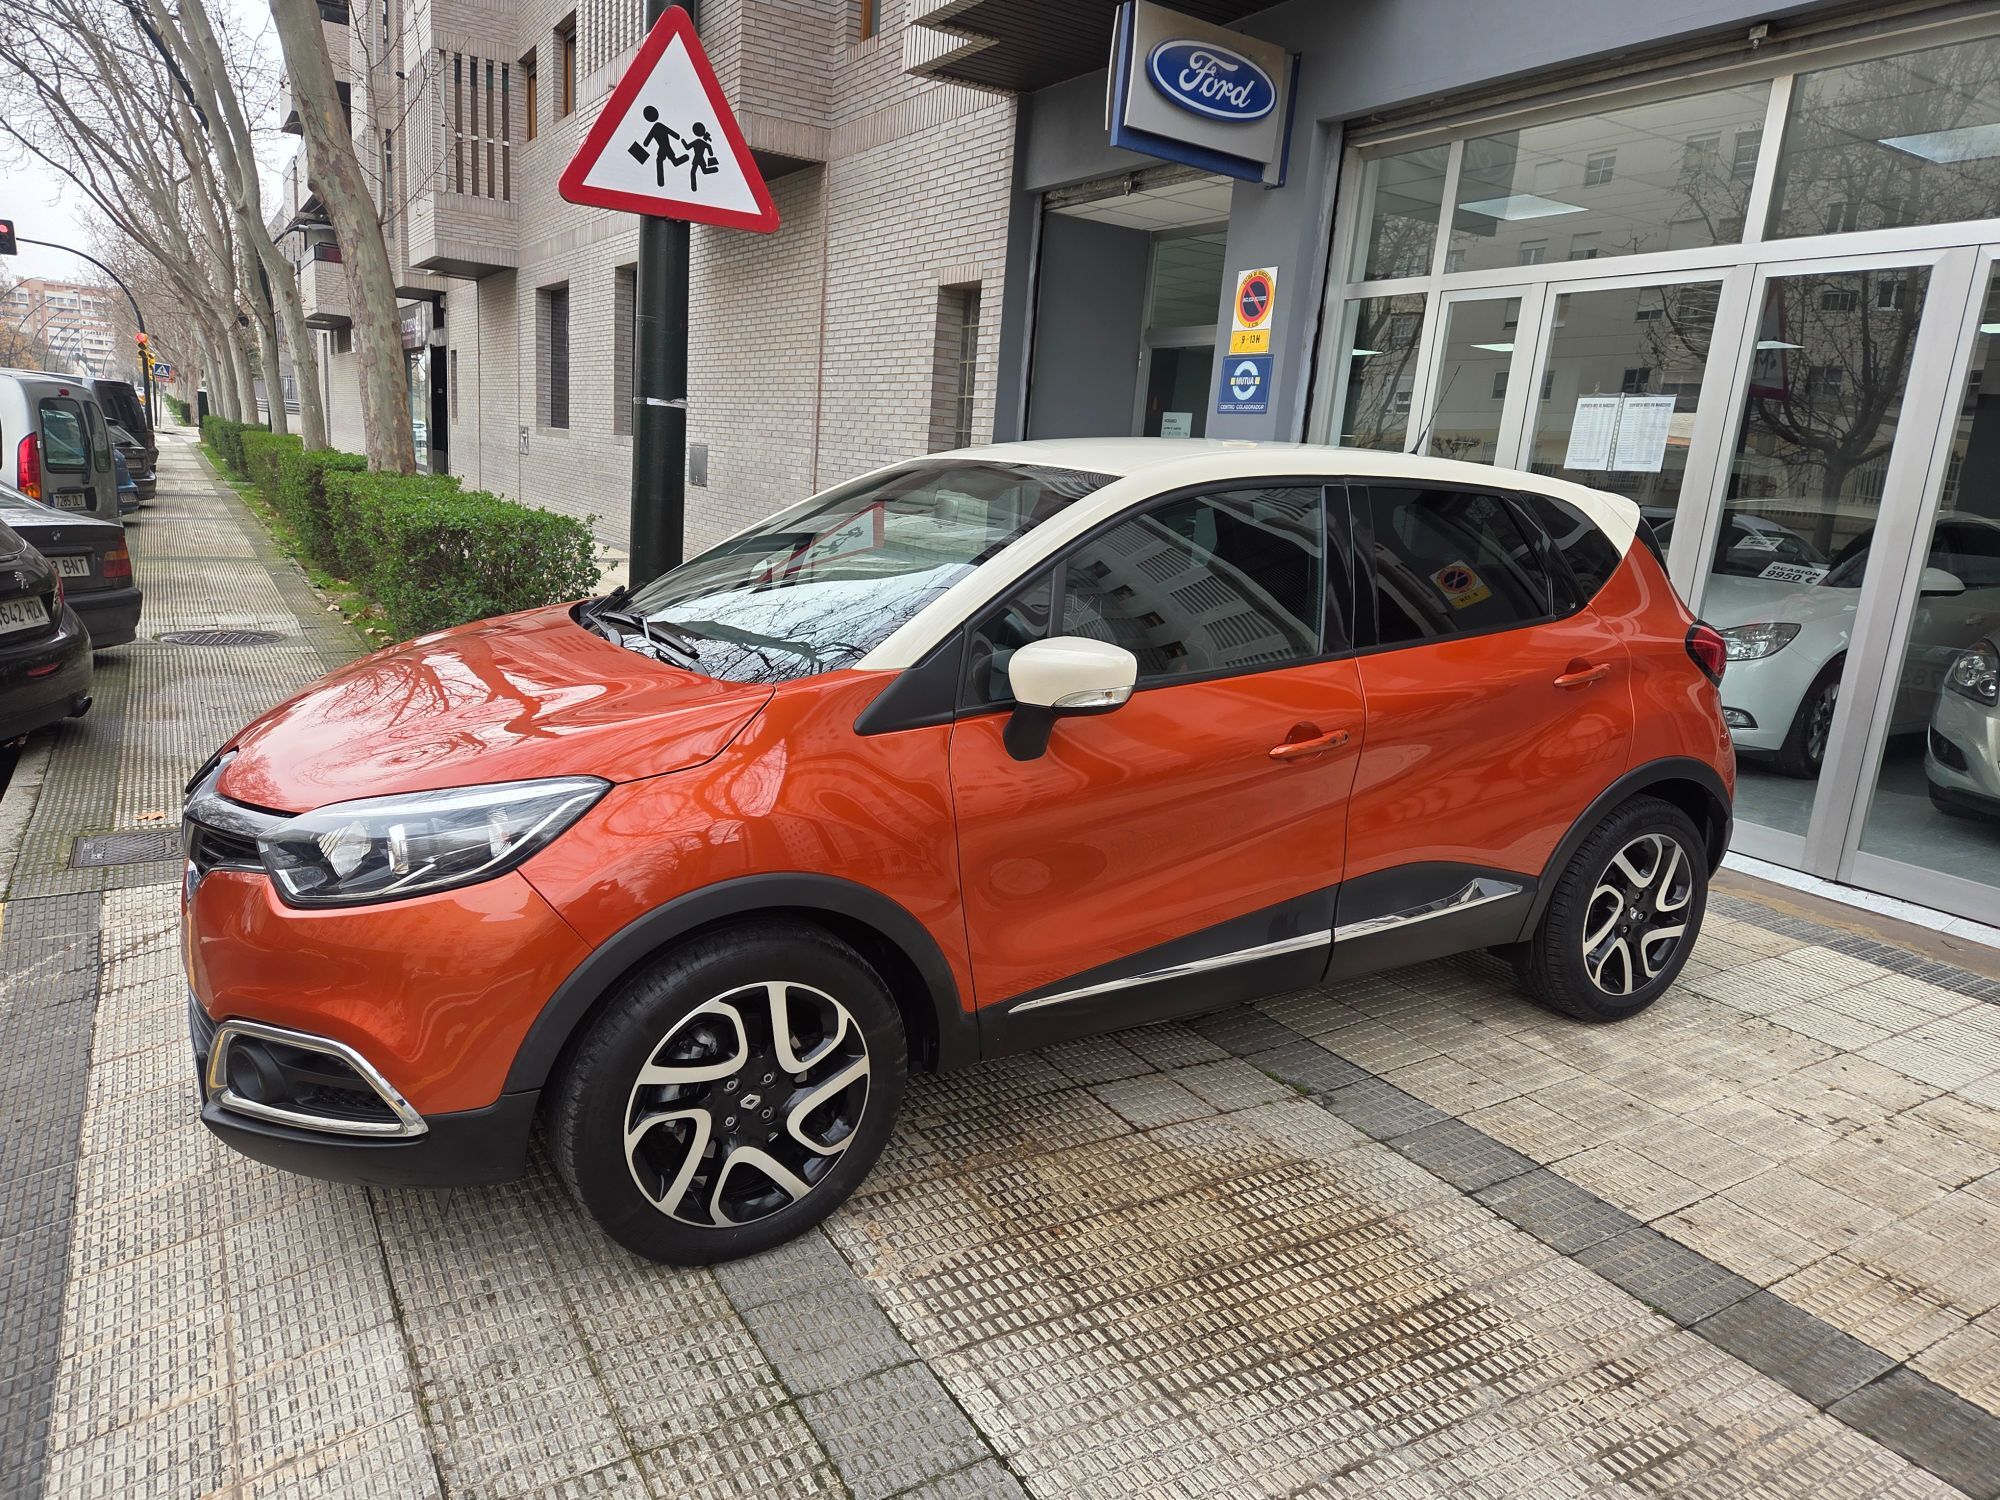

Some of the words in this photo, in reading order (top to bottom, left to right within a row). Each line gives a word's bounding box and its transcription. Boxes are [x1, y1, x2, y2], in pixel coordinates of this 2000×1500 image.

[1178, 50, 1255, 108] Ford
[1236, 377, 1254, 385] MUTUA
[62, 559, 87, 575] BNT
[1765, 570, 1803, 581] 9950
